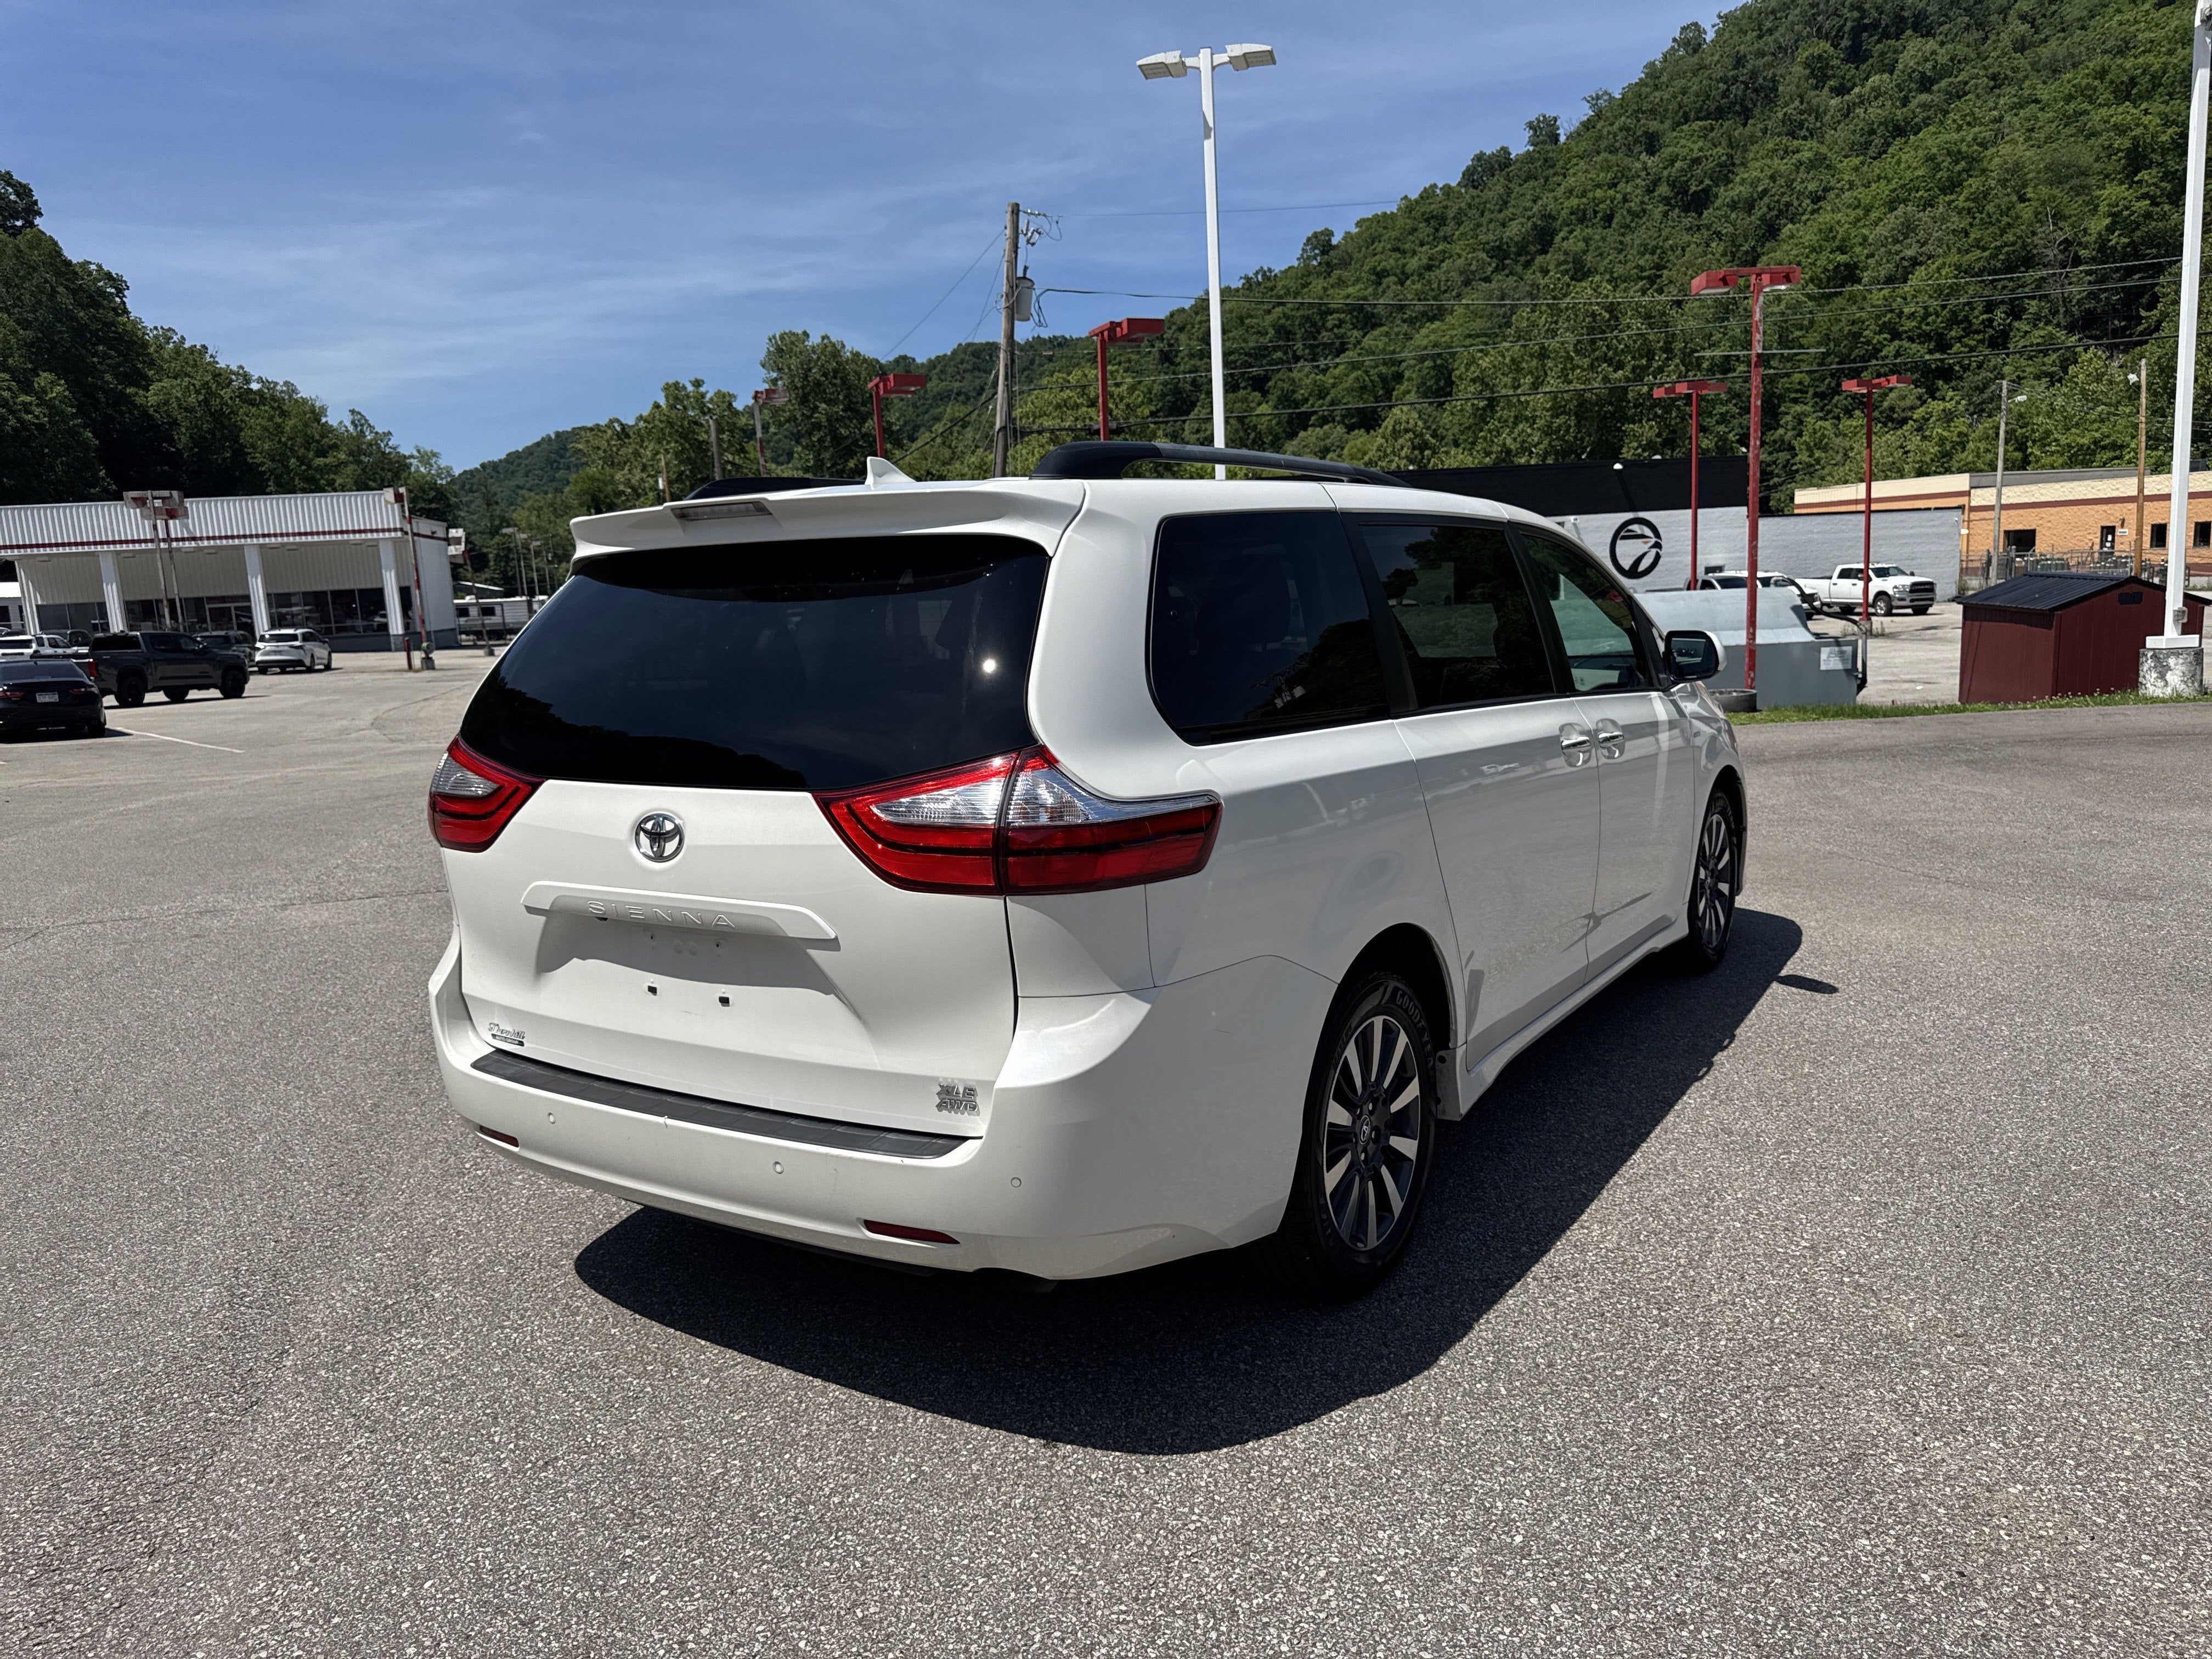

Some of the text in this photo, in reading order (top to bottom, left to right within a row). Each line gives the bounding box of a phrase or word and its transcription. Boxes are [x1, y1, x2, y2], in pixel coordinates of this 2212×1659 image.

[587, 900, 736, 928] SIENNA
[936, 1082, 978, 1099] XLE
[935, 1098, 979, 1113] AWD
